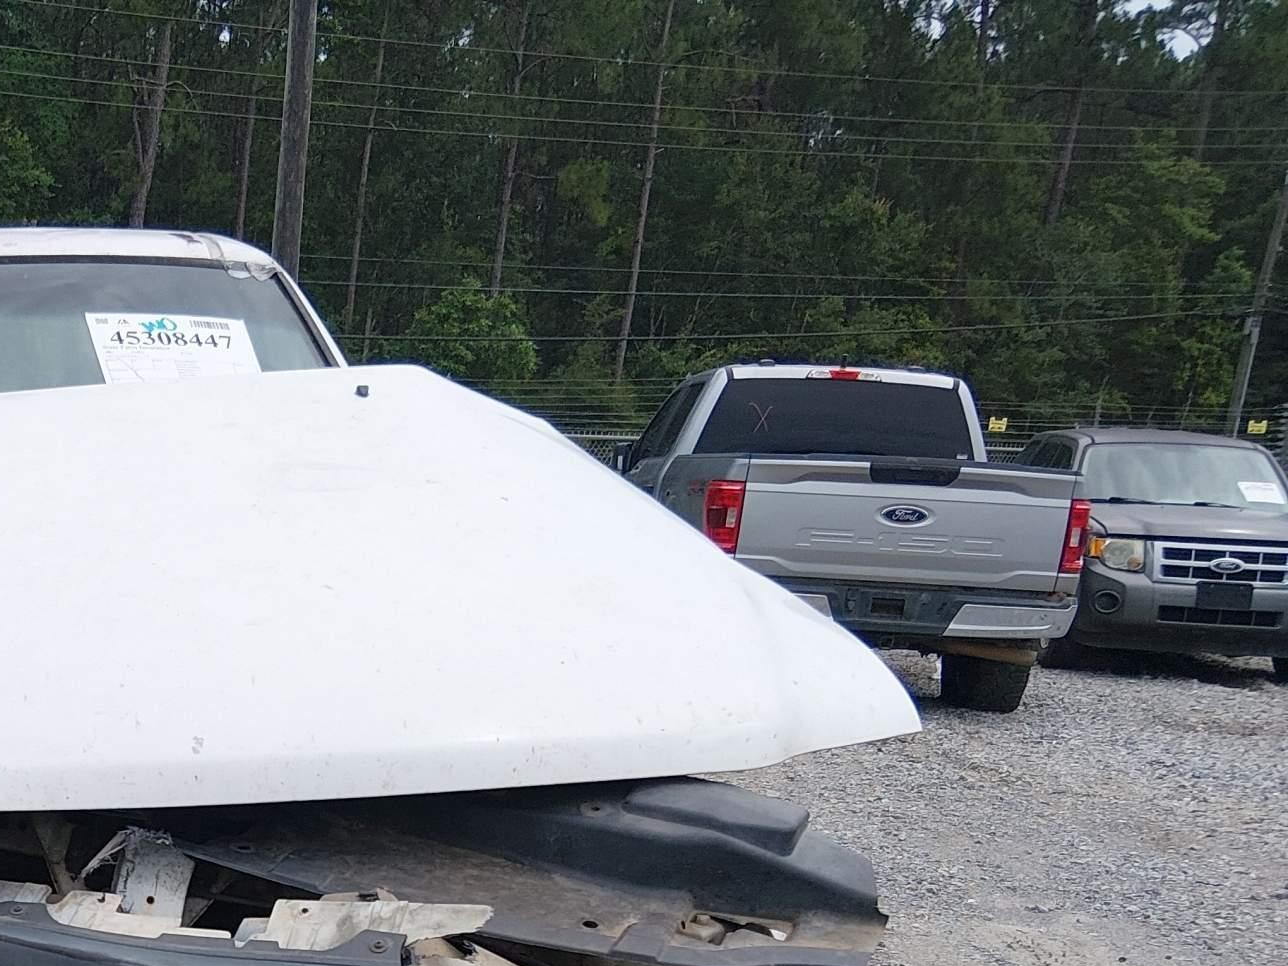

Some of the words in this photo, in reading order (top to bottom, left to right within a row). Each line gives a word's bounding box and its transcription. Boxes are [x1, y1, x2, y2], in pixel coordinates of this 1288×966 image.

[110, 330, 232, 350] 45308447
[891, 508, 920, 521] Ford
[794, 527, 1006, 557] F-150
